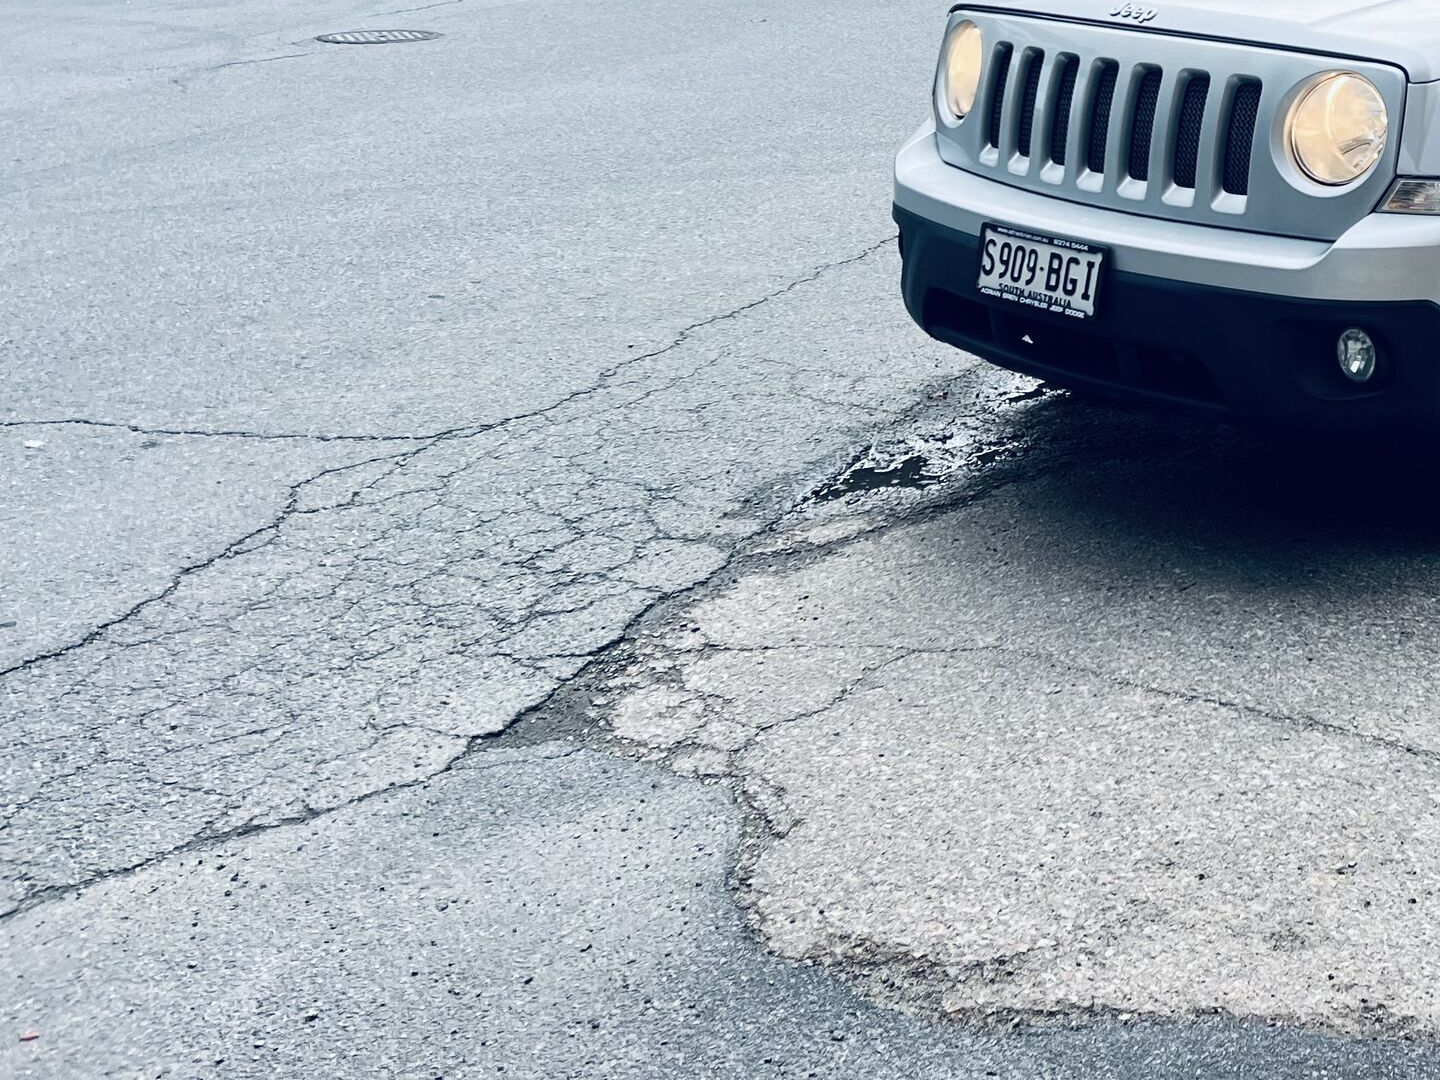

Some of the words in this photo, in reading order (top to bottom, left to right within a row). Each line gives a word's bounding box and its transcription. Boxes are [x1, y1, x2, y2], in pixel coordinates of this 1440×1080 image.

[1107, 2, 1159, 24] Jeep
[998, 282, 1026, 298] SOUTH
[1028, 290, 1072, 308] AUSTRALIA
